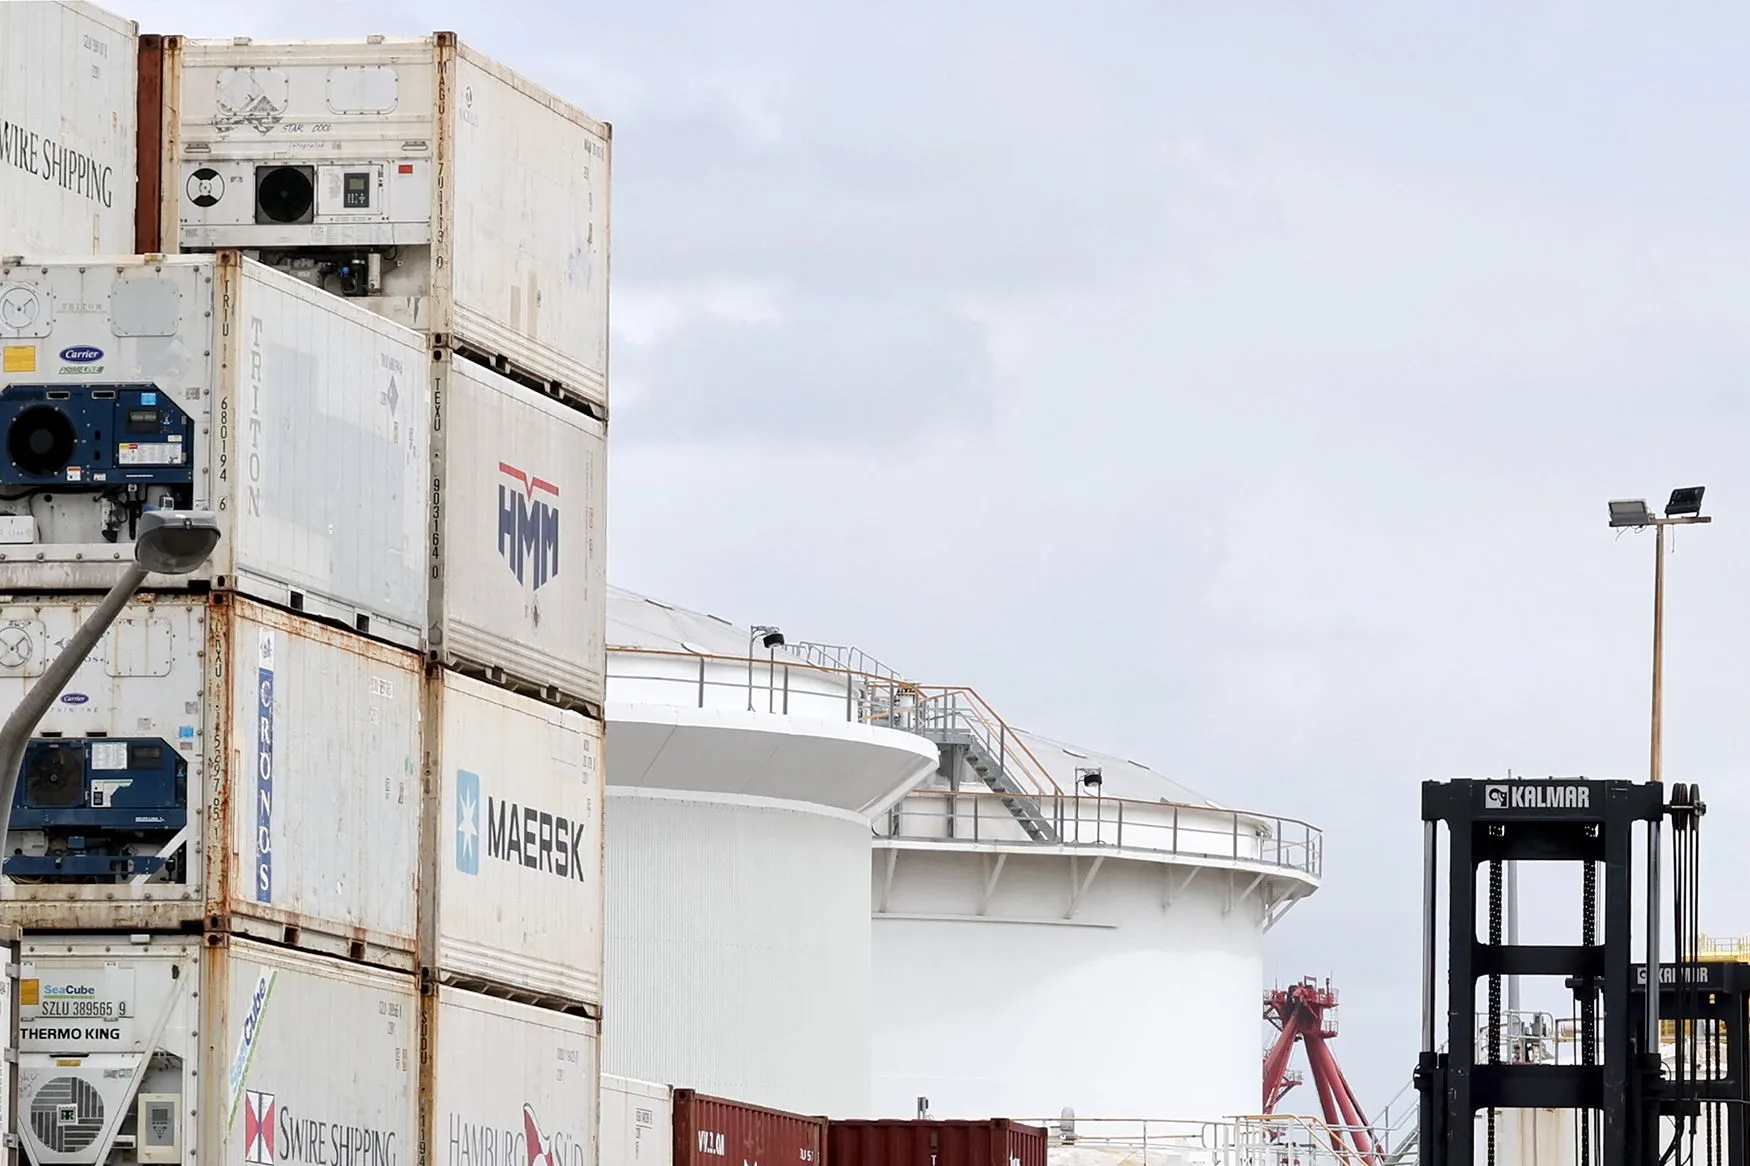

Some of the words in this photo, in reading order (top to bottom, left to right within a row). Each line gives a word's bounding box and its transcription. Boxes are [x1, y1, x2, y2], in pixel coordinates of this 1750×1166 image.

[436, 60, 449, 116] MAGU
[43, 138, 112, 208] SHIPPING
[222, 279, 230, 337] TRIU
[64, 348, 99, 359] Carrier
[219, 396, 228, 482] 680194
[248, 315, 263, 518] TRITON
[219, 496, 227, 511] 6
[432, 479, 440, 560] 903164
[498, 483, 559, 591] HMM
[432, 566, 439, 579] 0
[63, 694, 86, 702] Carrier
[260, 680, 272, 891] CRONOS
[1511, 786, 1590, 808] KALMAR
[488, 796, 584, 882] MAERSK
[42, 1002, 70, 1015] SZLU
[72, 1001, 113, 1015] 389565
[119, 1002, 126, 1015] 9
[44, 984, 95, 995] SeaCube
[20, 1028, 82, 1040] THERMO
[85, 1028, 120, 1040] KING
[420, 1011, 429, 1065] SUDU
[280, 1105, 327, 1166] SWIRE
